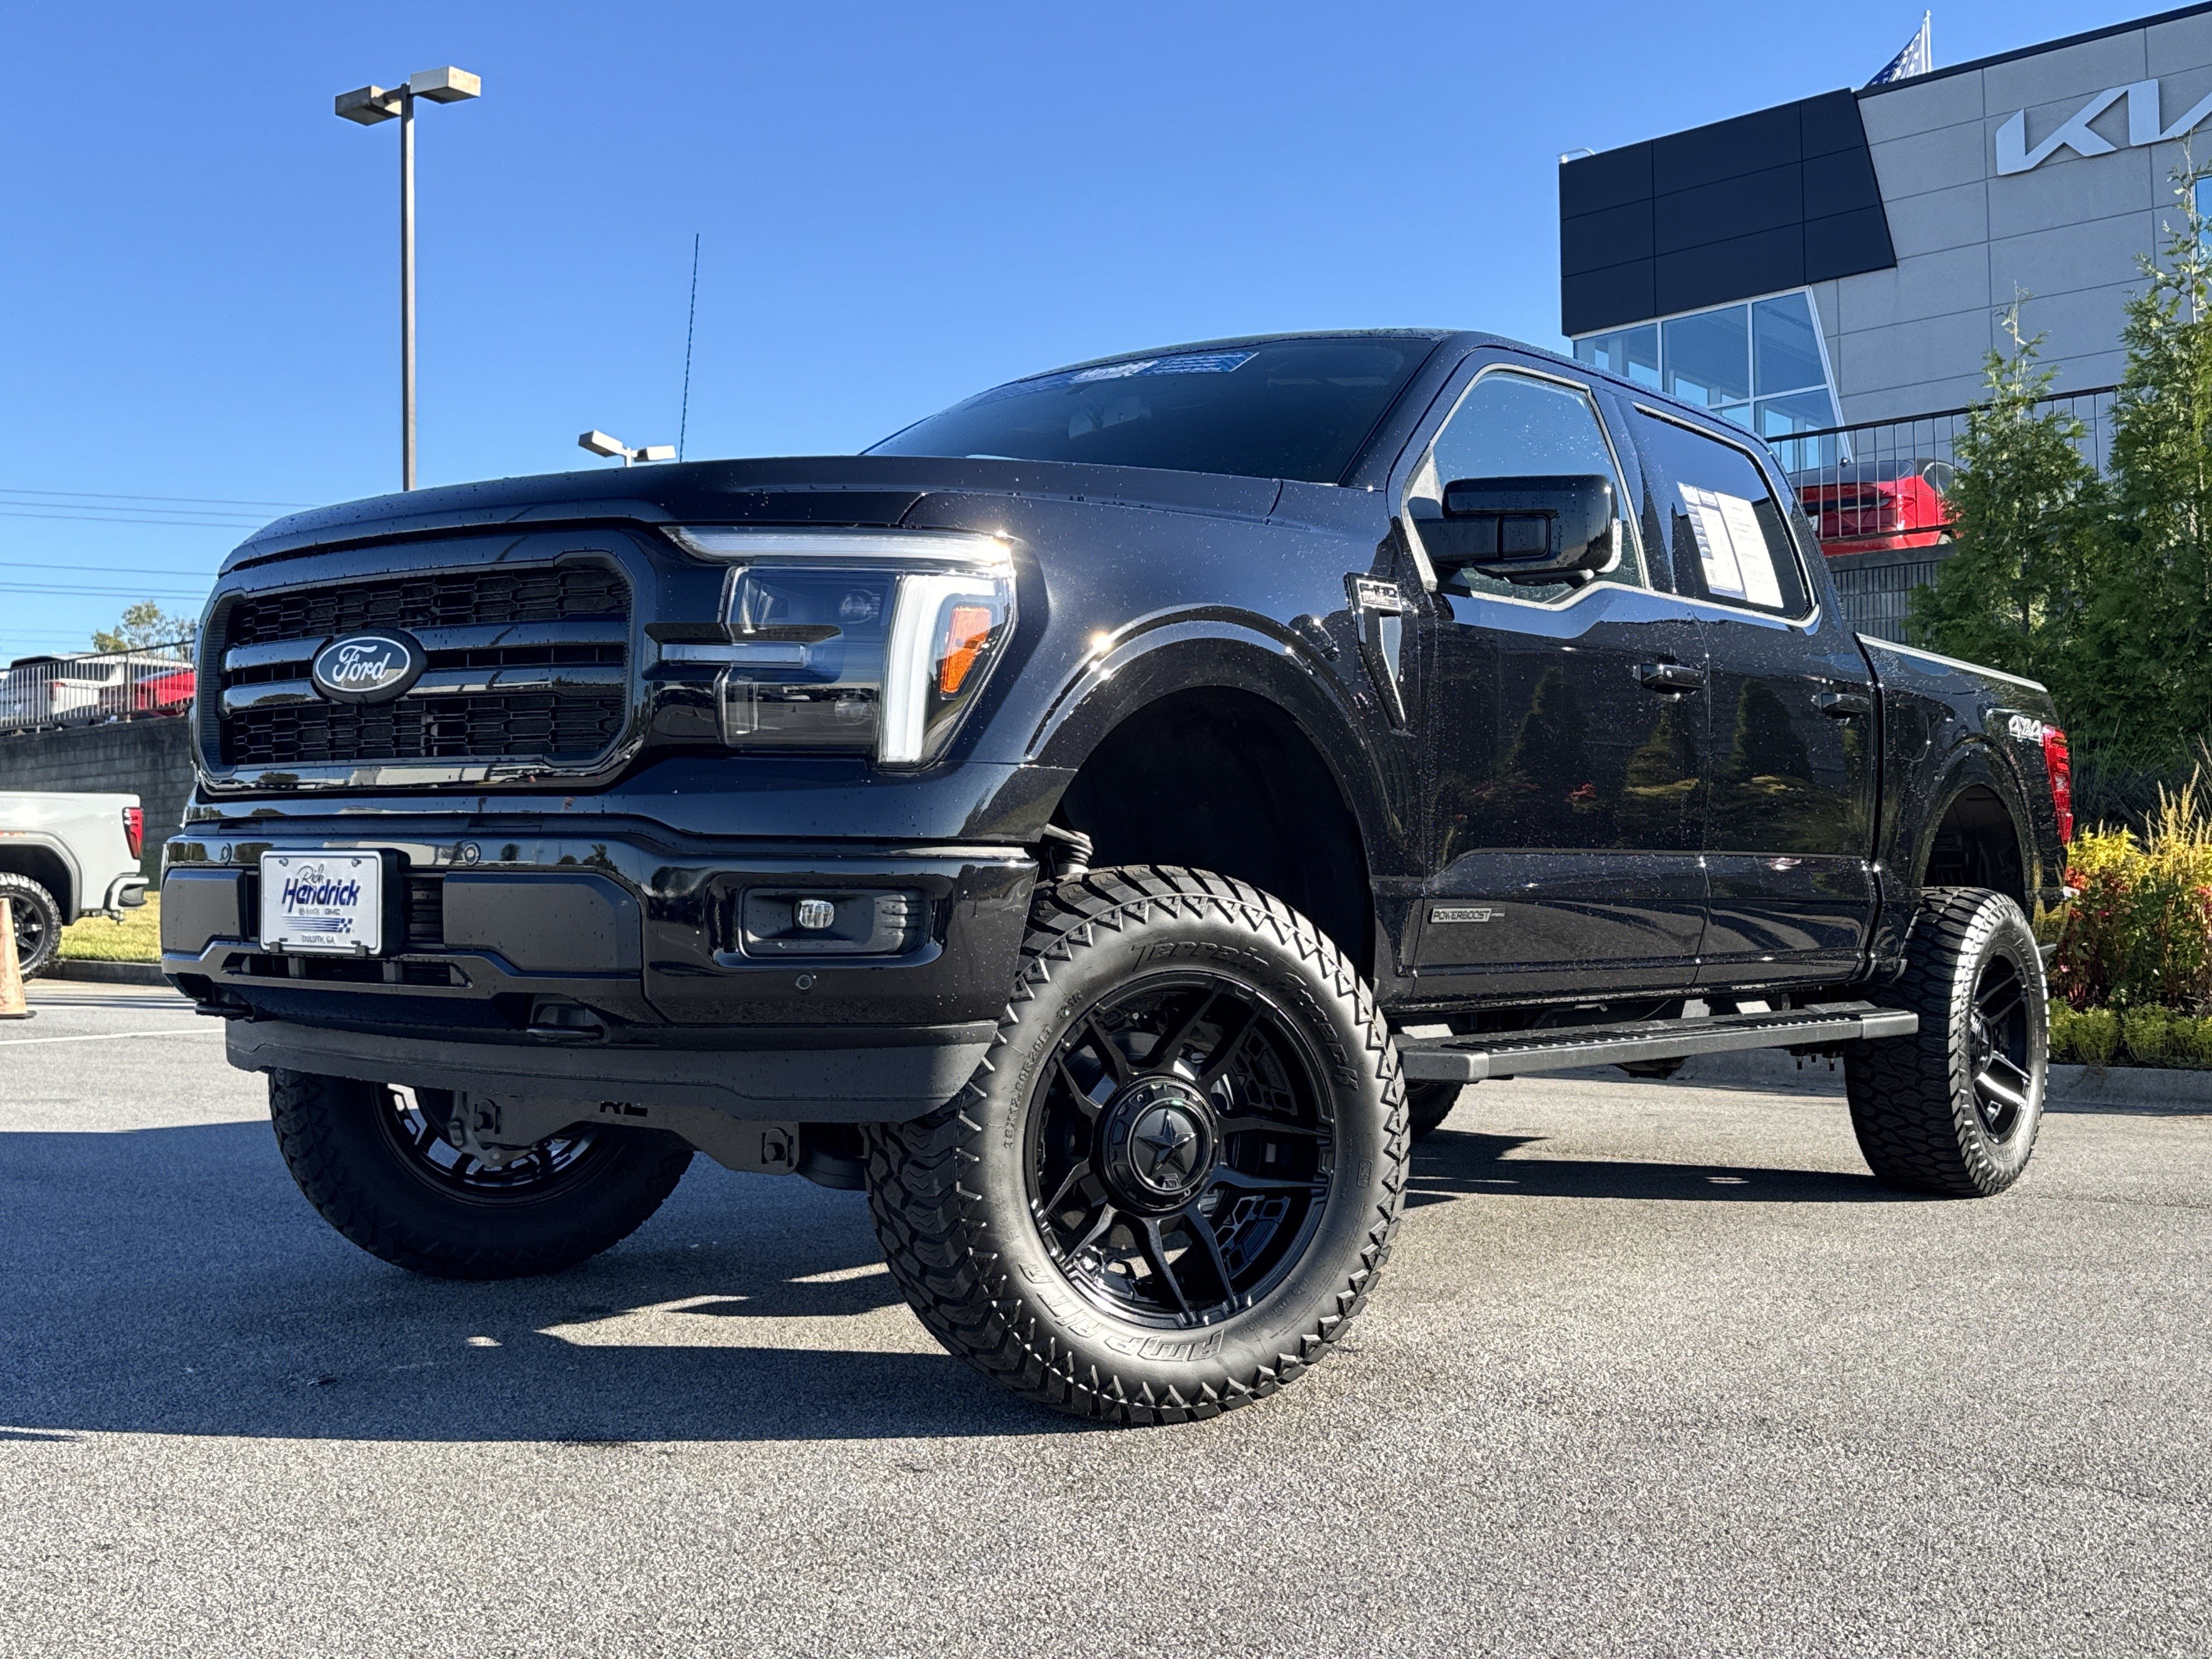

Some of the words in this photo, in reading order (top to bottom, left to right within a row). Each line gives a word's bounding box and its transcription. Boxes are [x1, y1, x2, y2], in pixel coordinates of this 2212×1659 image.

[332, 645, 391, 682] Ford
[297, 864, 325, 888] Rick
[281, 878, 361, 913] Hendrick
[1433, 910, 1489, 920] POWERBOOST
